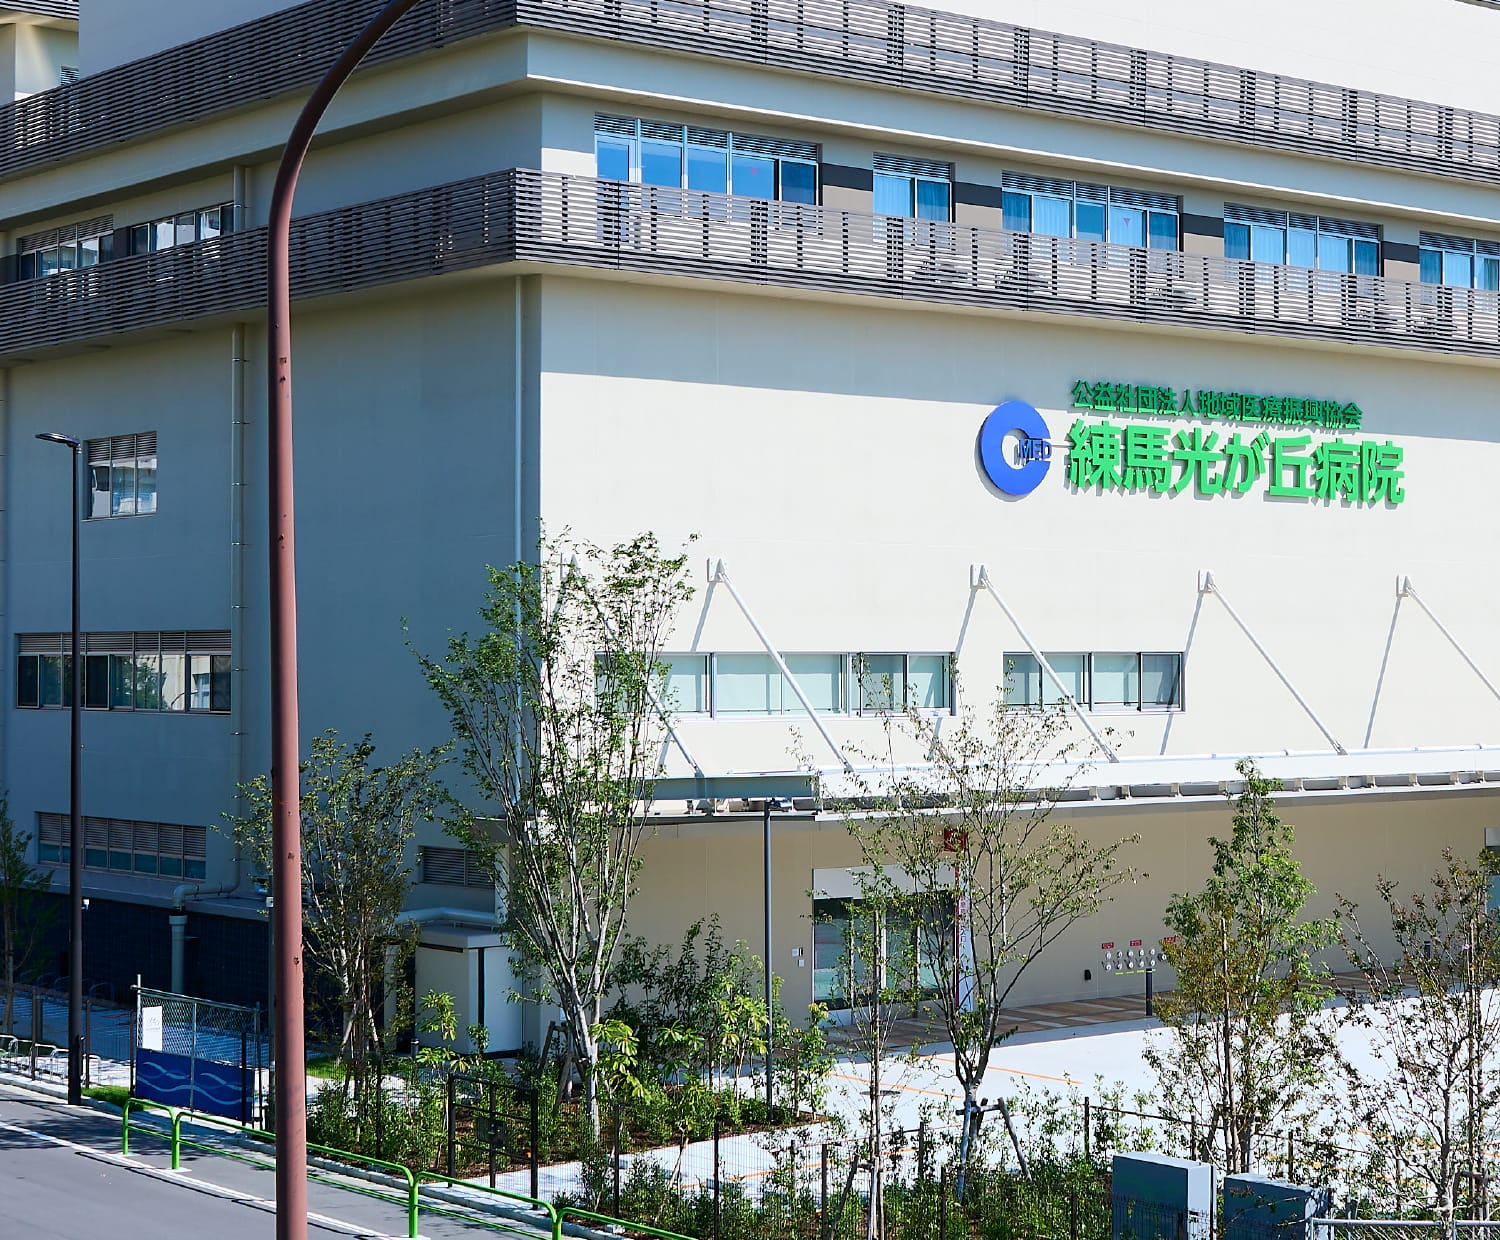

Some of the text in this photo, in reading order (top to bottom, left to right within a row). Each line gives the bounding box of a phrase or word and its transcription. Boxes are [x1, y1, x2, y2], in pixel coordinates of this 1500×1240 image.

[1071, 379, 1363, 430] 公益社団法人地域医療振興協会
[1019, 439, 1052, 460] MED
[1069, 418, 1406, 504] 練馬光が丘病院
